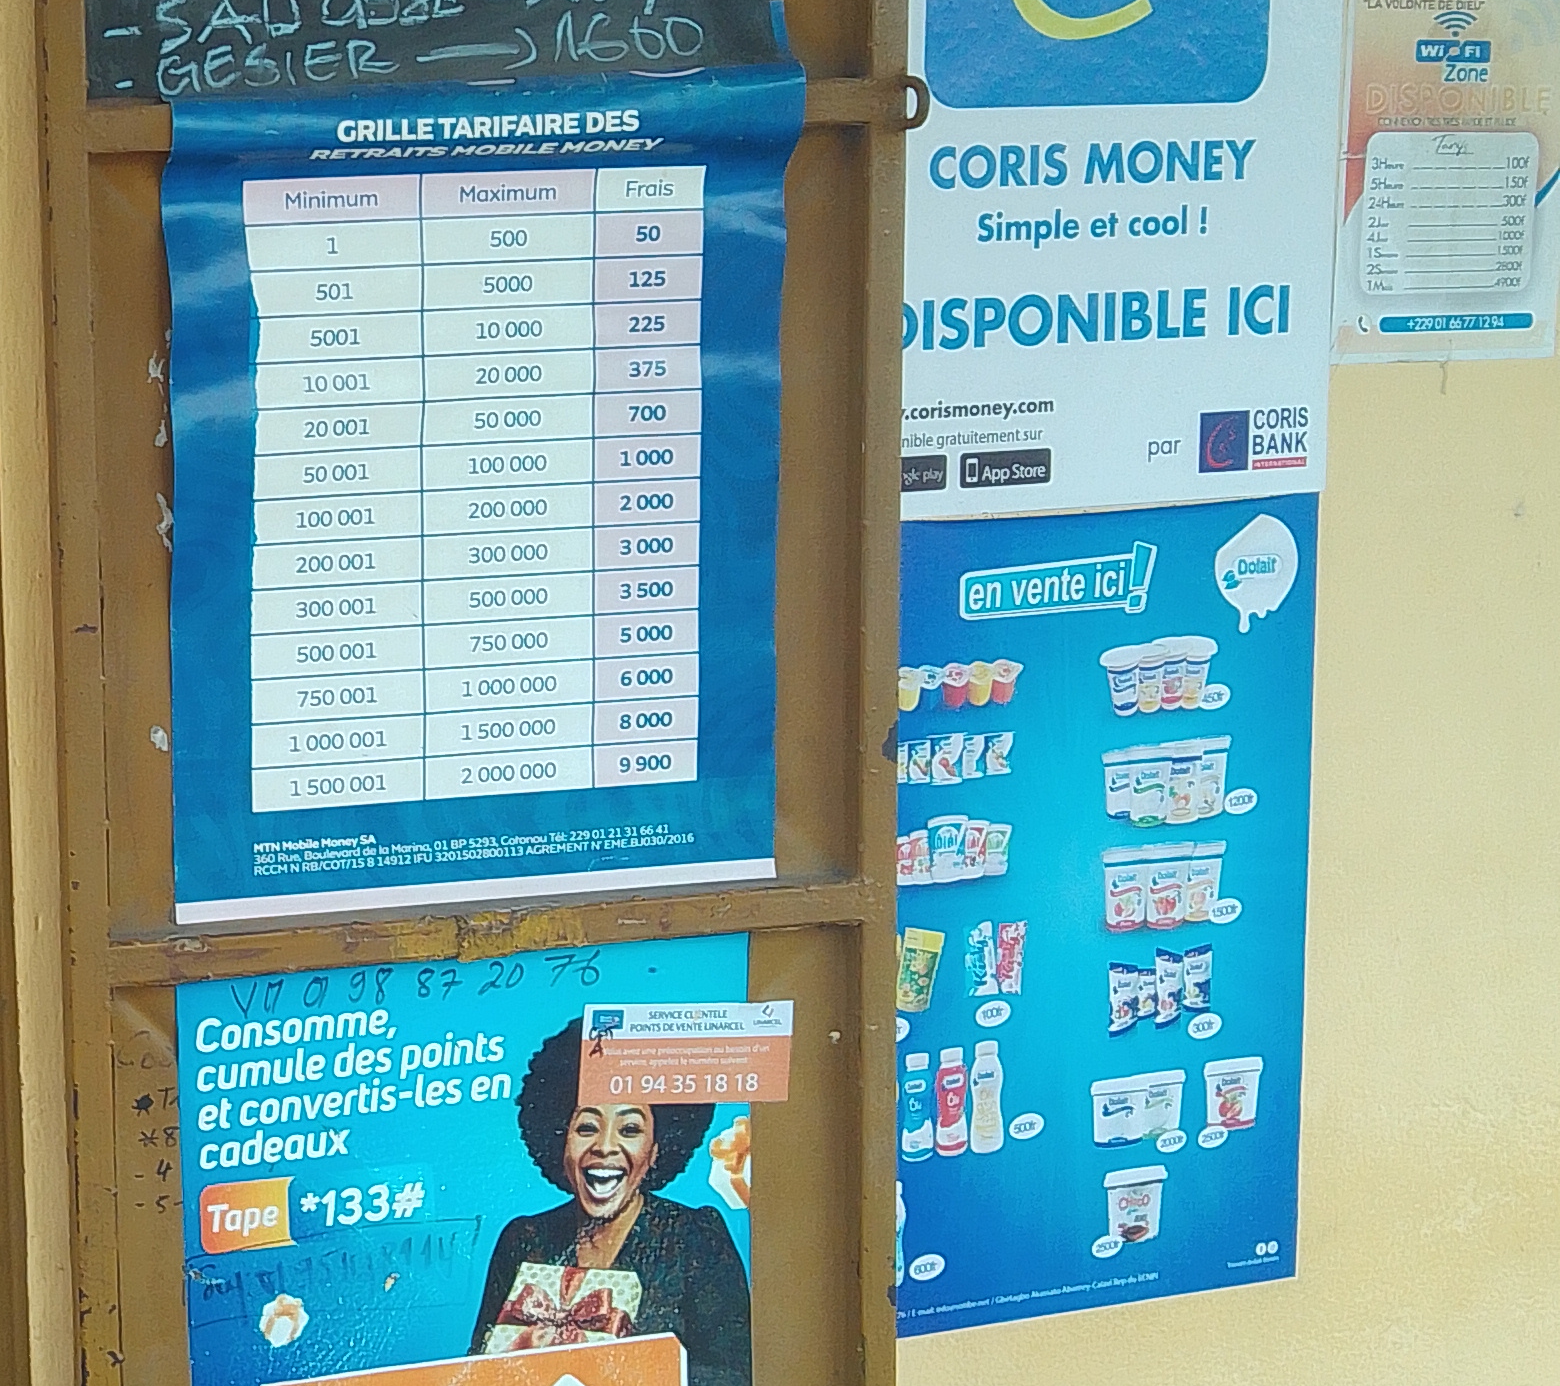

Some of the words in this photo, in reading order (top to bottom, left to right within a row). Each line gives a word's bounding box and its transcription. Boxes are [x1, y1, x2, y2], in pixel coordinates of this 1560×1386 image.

[1385, 0, 1435, 10] VOLONTE
[1440, 1, 1453, 10] DE
[1444, 64, 1488, 82] Zone
[1367, 83, 1551, 113] DISPONIBLE
[336, 118, 434, 143] GRILLE
[438, 112, 580, 139] TARIFAIRE
[586, 109, 640, 134] DES
[308, 145, 446, 161] RETRAITS
[451, 141, 560, 157] MOBILE
[561, 136, 665, 154] MONEY
[930, 143, 1068, 189] CORIS
[1084, 139, 1257, 185] MONEY
[283, 189, 379, 210] Minimum
[459, 182, 557, 204] Maximum
[624, 178, 674, 199] Frais
[326, 237, 338, 255] 1
[489, 229, 527, 248] 500
[635, 224, 661, 244] 50
[977, 209, 1079, 248] Simple
[1090, 212, 1118, 238] et
[1129, 205, 1187, 236] cool
[315, 282, 353, 302] 501
[483, 275, 533, 294] 5000
[628, 270, 666, 289] 125
[1228, 285, 1290, 334] ICI
[309, 328, 360, 348] 5001
[627, 315, 666, 334] 225
[902, 398, 1054, 421] .corismoney.com
[937, 429, 1020, 449] gratuitement
[1023, 429, 1042, 442] sur
[1148, 436, 1180, 462] par
[1253, 407, 1308, 430] CORIS
[982, 465, 1009, 483] App
[1012, 463, 1046, 479] Store
[1252, 432, 1308, 455] BANK
[1238, 554, 1279, 577] Dolait
[968, 581, 1002, 611] en
[1011, 569, 1086, 606] vente
[1093, 563, 1127, 599] ici
[253, 843, 280, 854] MTN
[282, 839, 319, 851] Mobile
[321, 837, 358, 850] Money
[359, 835, 376, 845] SA
[349, 970, 389, 1006] 98
[480, 959, 524, 991] 20
[630, 1023, 660, 1032] POINTS
[663, 1023, 674, 1031] DE
[675, 1022, 702, 1031] VENTE
[648, 1010, 682, 1019] SERVICE
[196, 1009, 397, 1053] Consomme,
[196, 1048, 325, 1092] cumule
[333, 1043, 392, 1079] des
[400, 1031, 505, 1080] points
[610, 1075, 632, 1094] 01
[640, 1075, 666, 1093] 94
[671, 1074, 695, 1092] 35
[704, 1074, 727, 1092] 18
[735, 1073, 758, 1091] 18
[198, 1097, 231, 1131] et
[239, 1077, 464, 1124] convertis-les
[470, 1075, 511, 1102] en
[199, 1129, 350, 1170] cadeaux
[207, 1203, 280, 1236] Tape
